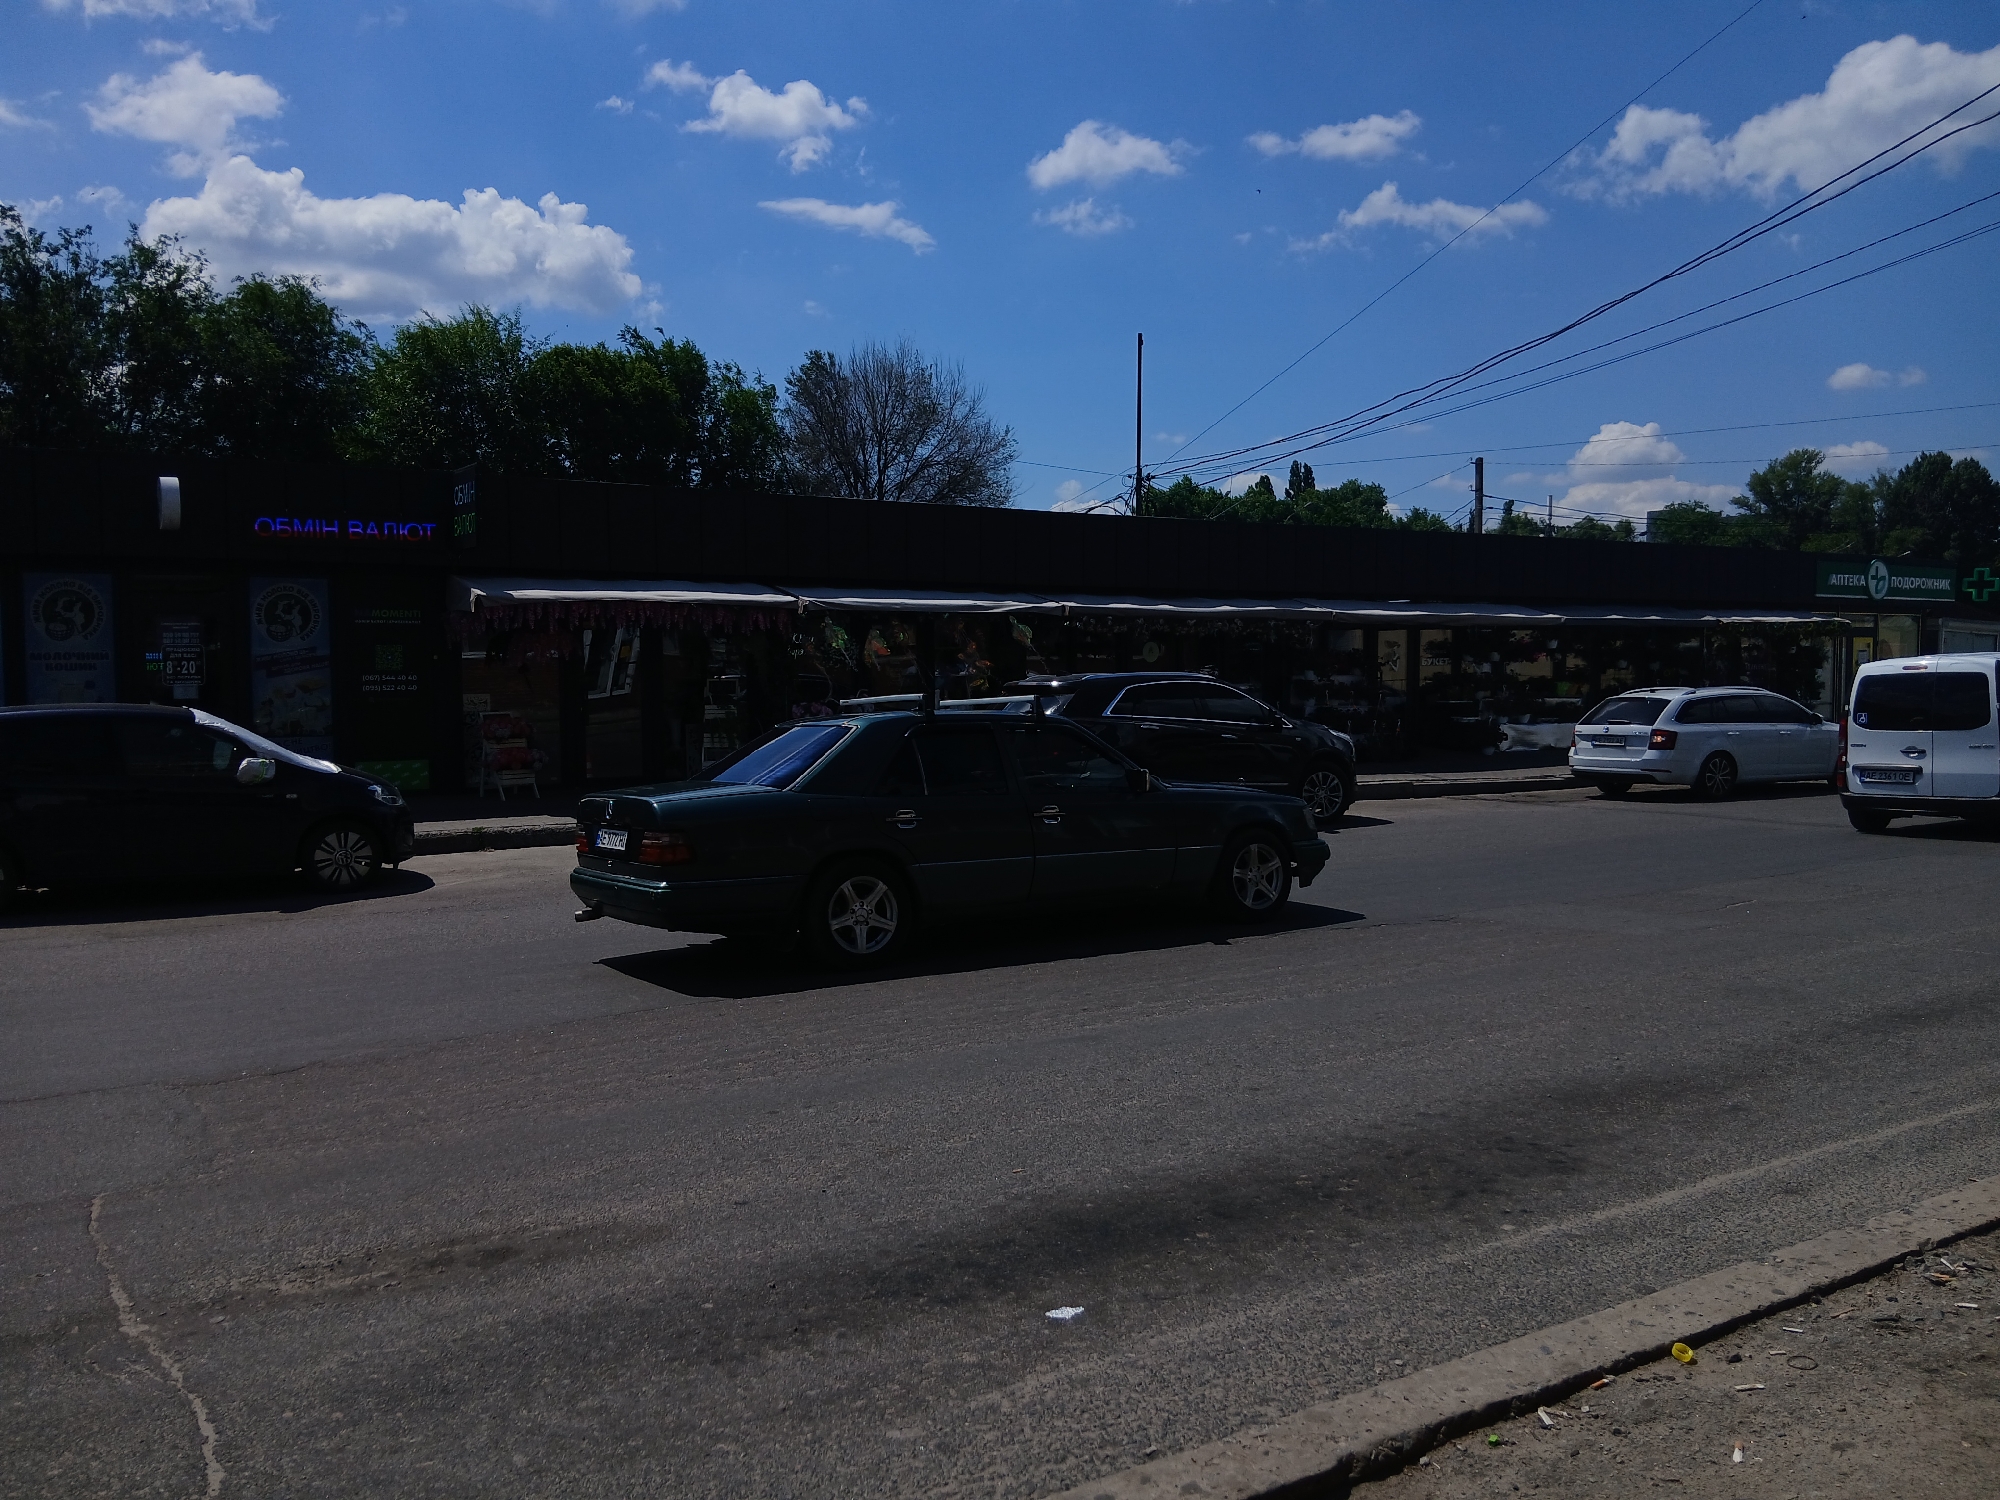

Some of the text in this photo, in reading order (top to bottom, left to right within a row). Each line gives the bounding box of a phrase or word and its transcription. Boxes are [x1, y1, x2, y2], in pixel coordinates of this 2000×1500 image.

[454, 480, 475, 506] ОБМІН
[255, 517, 437, 541] ОБМІН ВАЛЮТ
[453, 512, 476, 537] ВАЛЮТ
[38, 581, 76, 599] МОЛОКО
[1828, 573, 1951, 591] АПТЕКА ПОДОРОЖНИК
[254, 603, 264, 625] ЖИВЕ
[261, 585, 294, 601] МОЛОКО
[296, 588, 310, 600] ВІД
[29, 650, 110, 661] МОЛОЧНИЙ
[45, 662, 98, 672] КОШИК
[1866, 771, 1877, 780] AE
[1877, 772, 1897, 781] 2361
